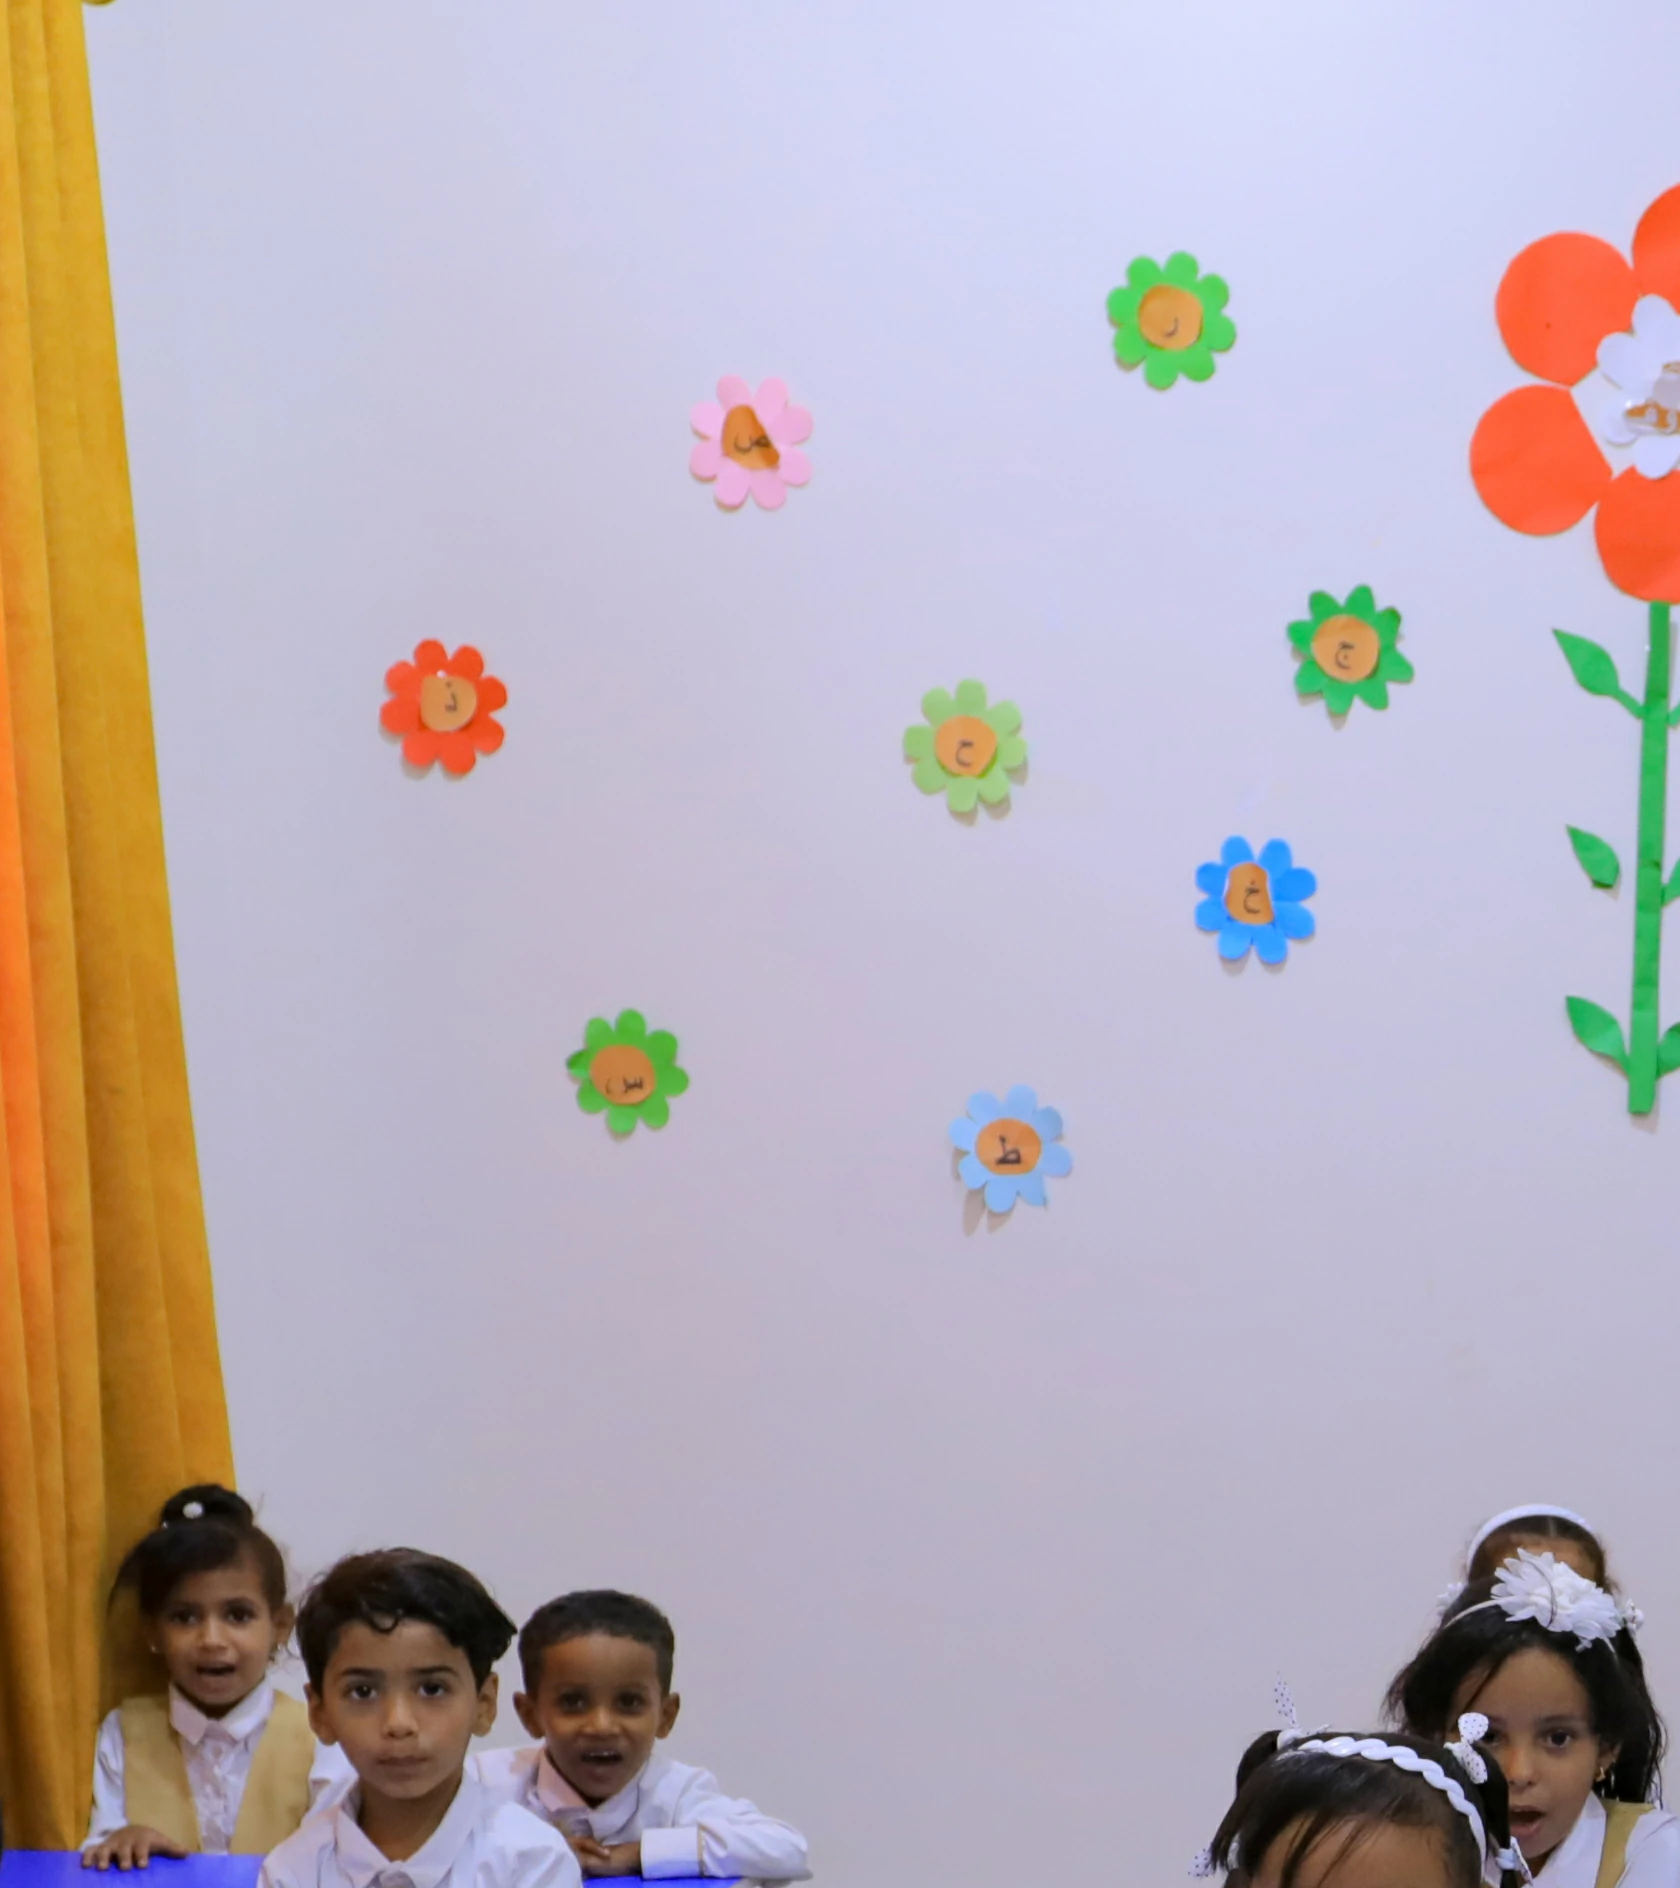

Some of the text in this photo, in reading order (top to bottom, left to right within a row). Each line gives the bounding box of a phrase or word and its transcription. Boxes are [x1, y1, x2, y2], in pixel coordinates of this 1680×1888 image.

[1335, 641, 1355, 669] ج
[955, 739, 974, 768] ح
[1243, 880, 1261, 914] خ
